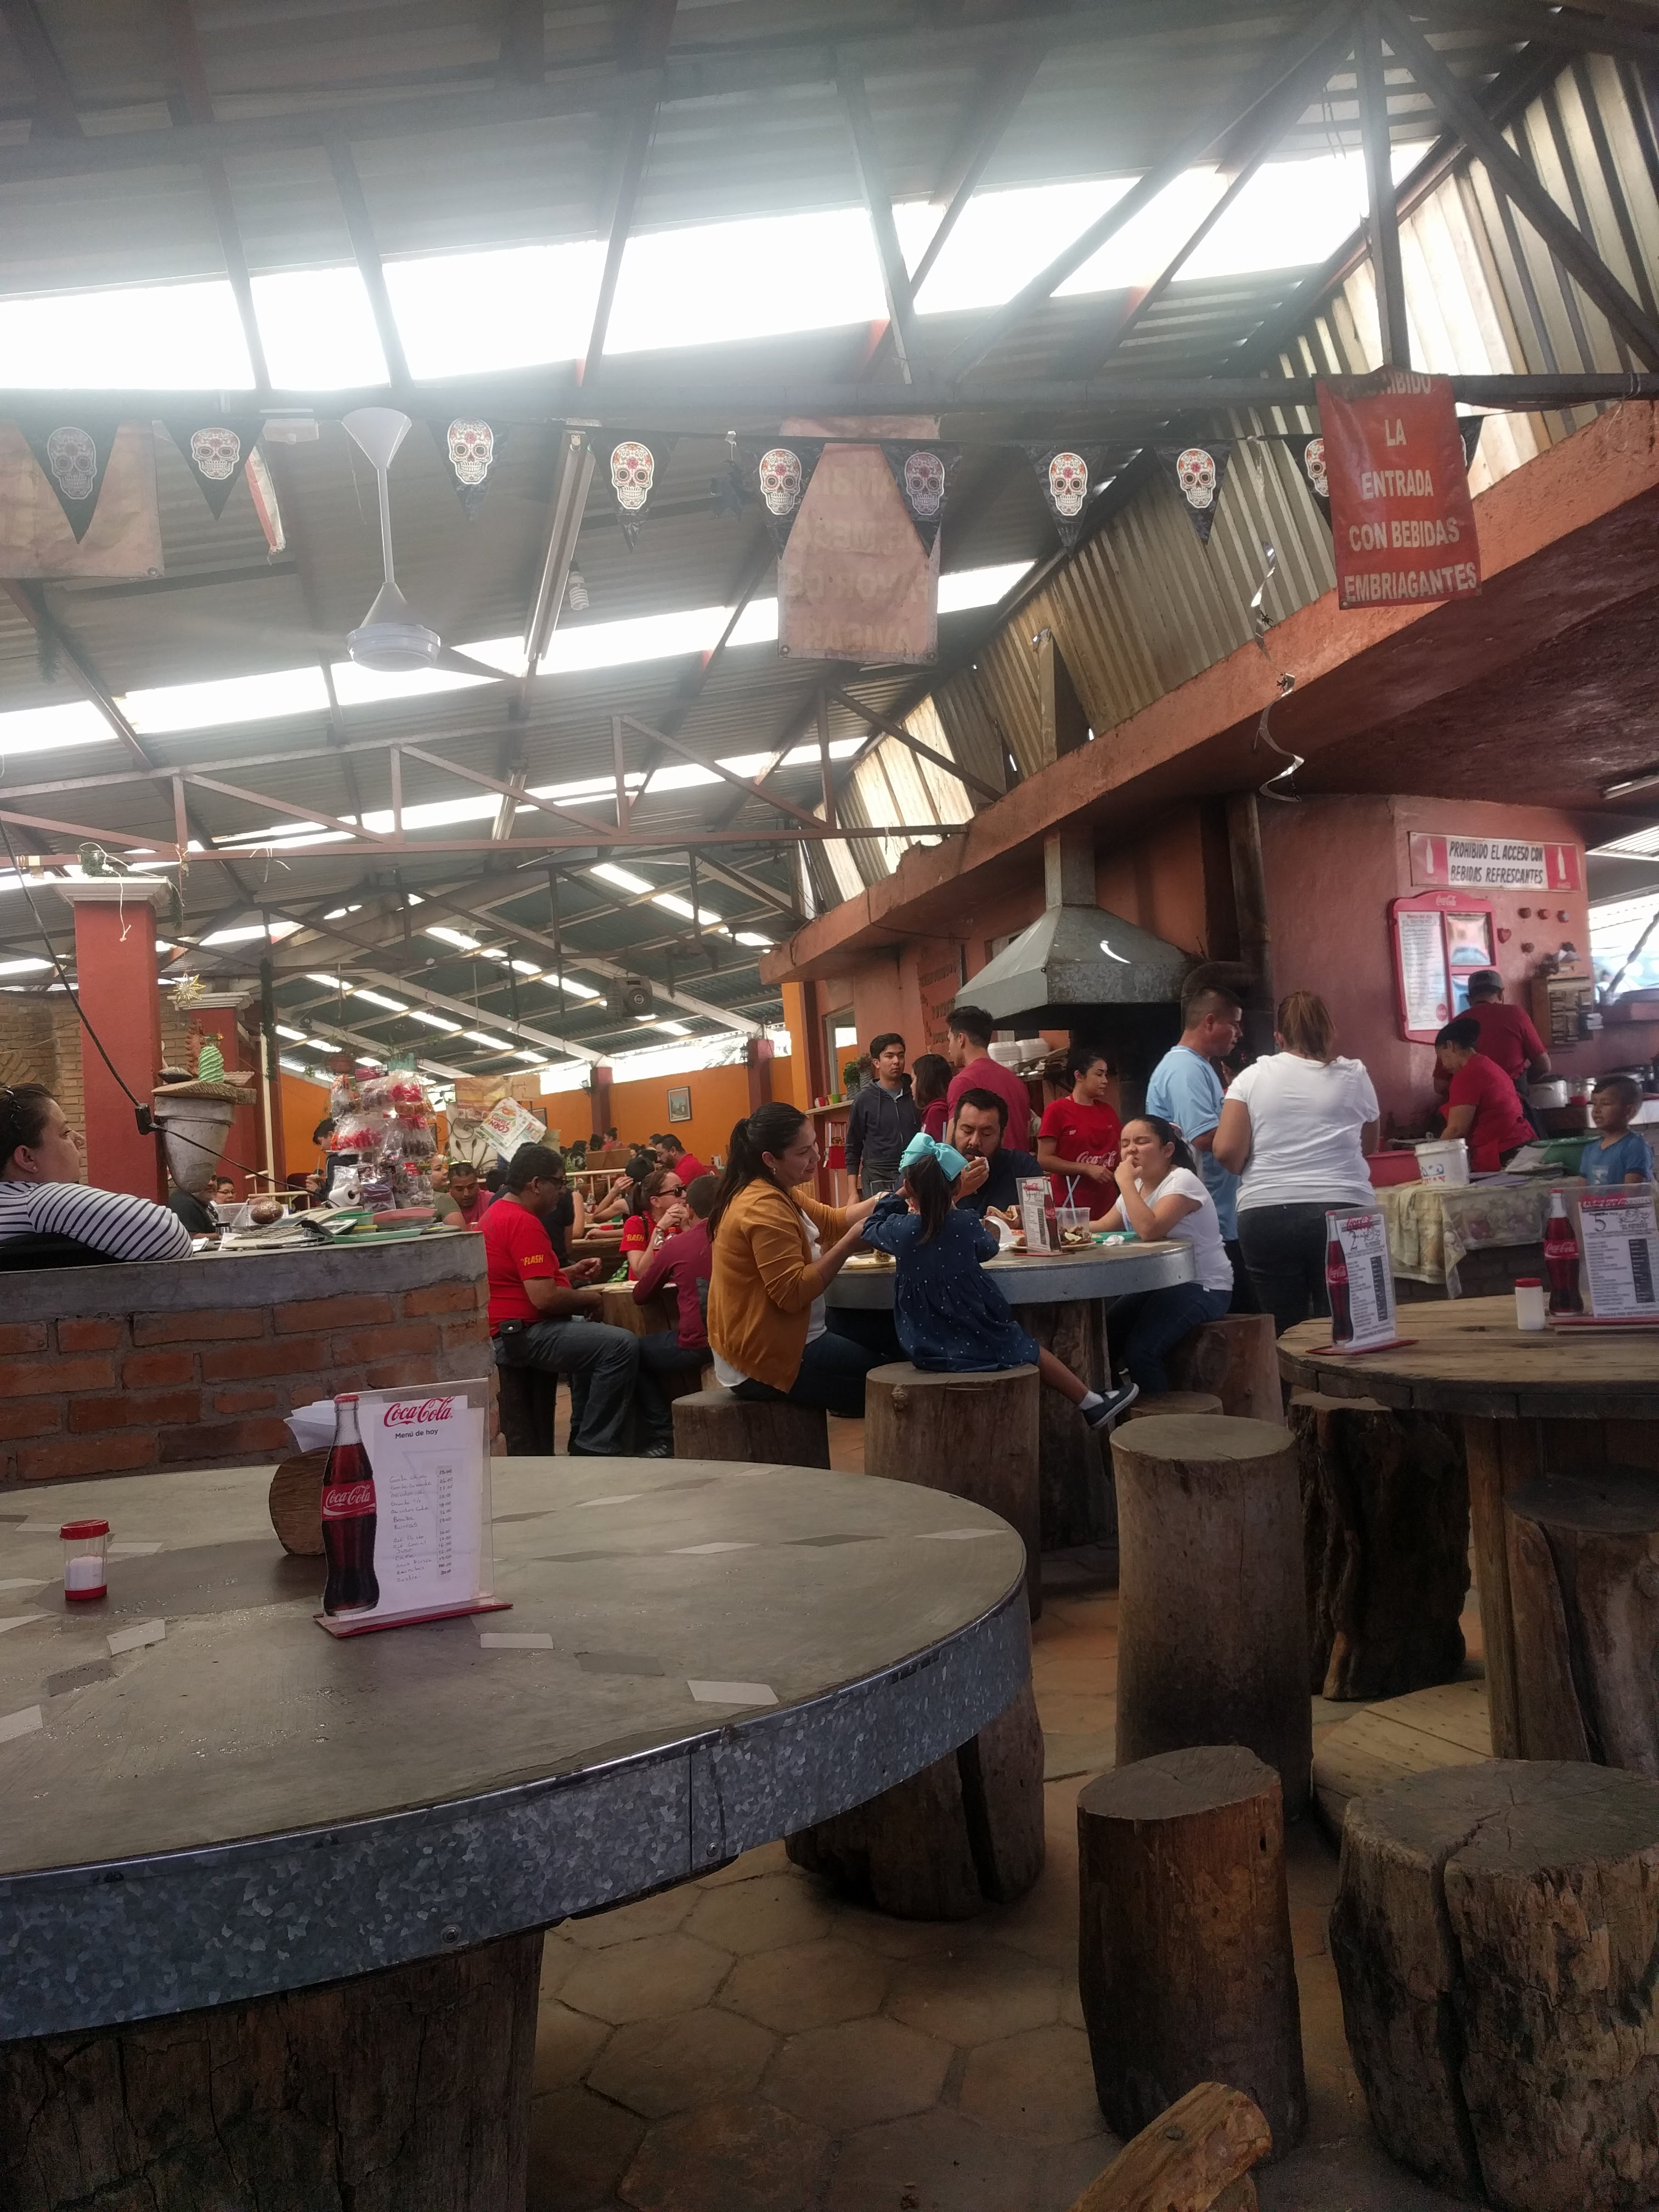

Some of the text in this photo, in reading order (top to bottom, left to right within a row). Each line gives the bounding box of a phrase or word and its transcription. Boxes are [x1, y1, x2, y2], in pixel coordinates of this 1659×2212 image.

[1384, 418, 1407, 447] LA
[1361, 469, 1435, 500] ENTRADA
[1348, 517, 1460, 552] CON BEBIDAS
[1344, 562, 1476, 603] EMBRIAGANTES
[1449, 841, 1543, 862] PROHIBIDO EL ACCESO CON
[1451, 865, 1543, 884] BEBIDAS REFRESCANTES
[488, 1120, 510, 1133] CORN
[523, 1255, 544, 1266] FLASH
[384, 1396, 454, 1427] Coca-Cola
[396, 1431, 413, 1439] Menú
[325, 1485, 370, 1508] Coca-Cola
